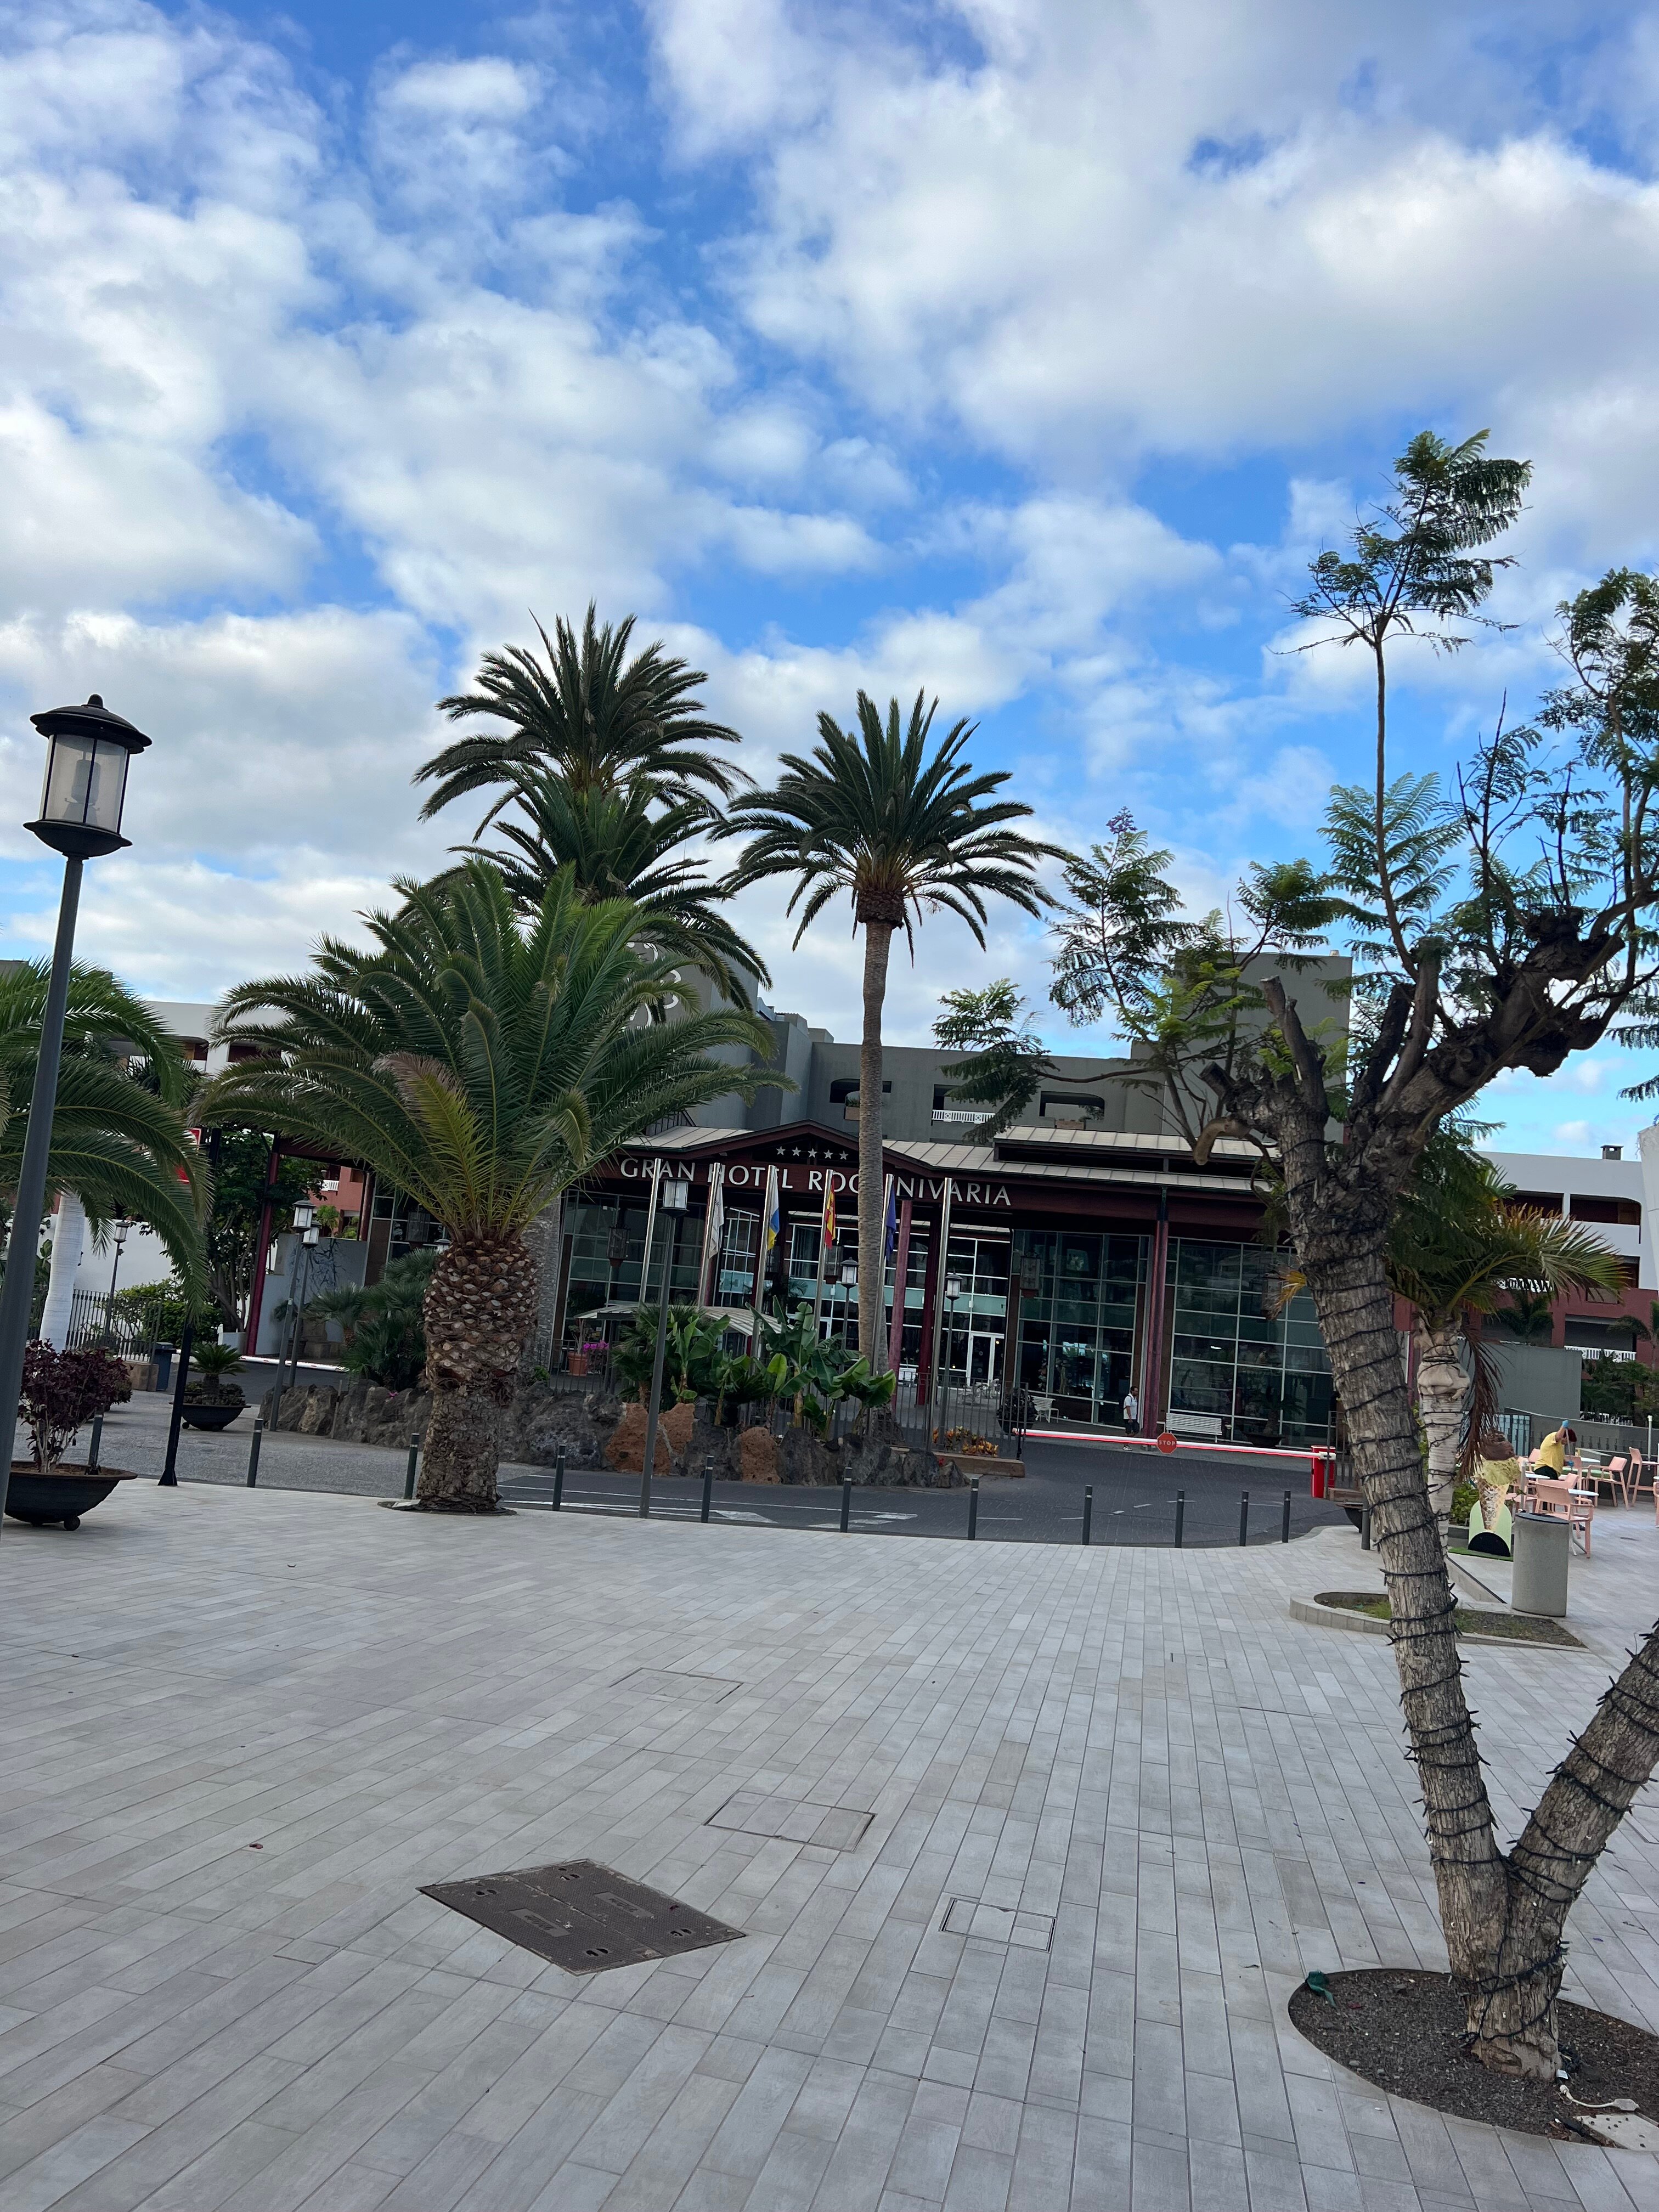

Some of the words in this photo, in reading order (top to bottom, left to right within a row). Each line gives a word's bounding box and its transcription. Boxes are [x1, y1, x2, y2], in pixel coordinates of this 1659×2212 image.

[620, 1158, 695, 1181] GRAN
[708, 1163, 793, 1189] HOTL
[896, 1176, 1011, 1206] NIVARIA
